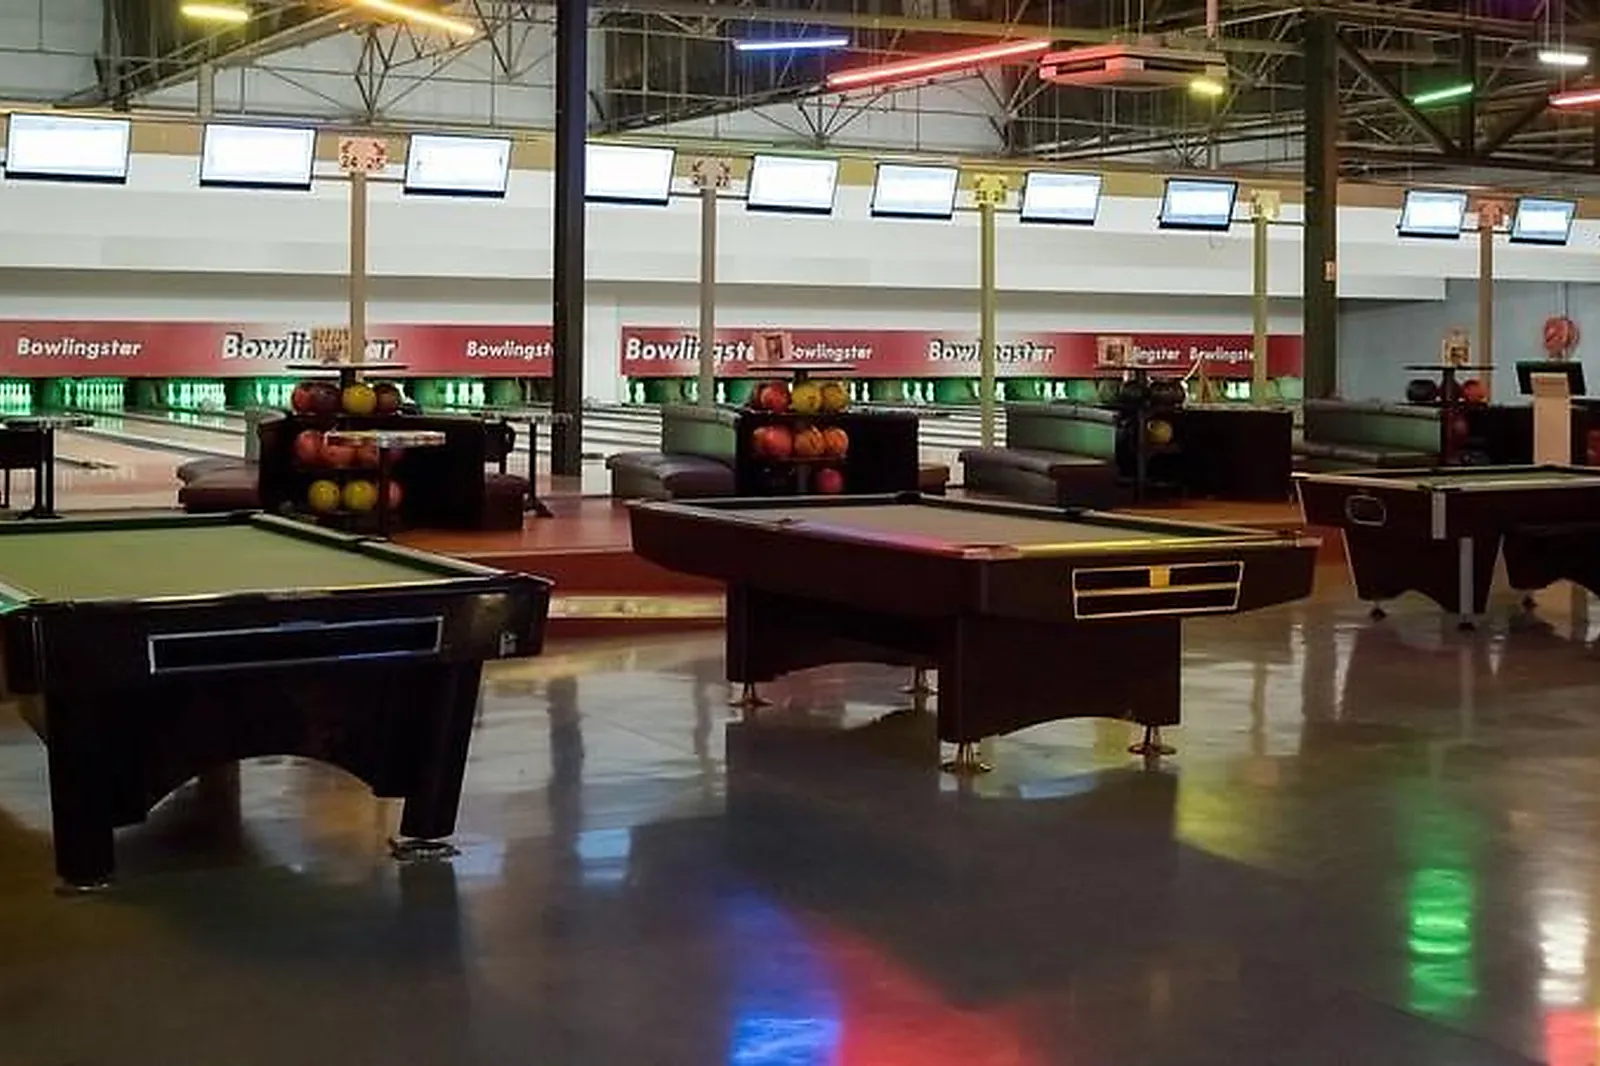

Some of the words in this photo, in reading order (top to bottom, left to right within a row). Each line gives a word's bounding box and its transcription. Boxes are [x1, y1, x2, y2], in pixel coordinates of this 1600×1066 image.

[222, 331, 399, 360] Bowlinar
[466, 340, 554, 361] Bowlingst
[790, 343, 873, 363] owlingstar
[928, 338, 1056, 366] Bowlgstar
